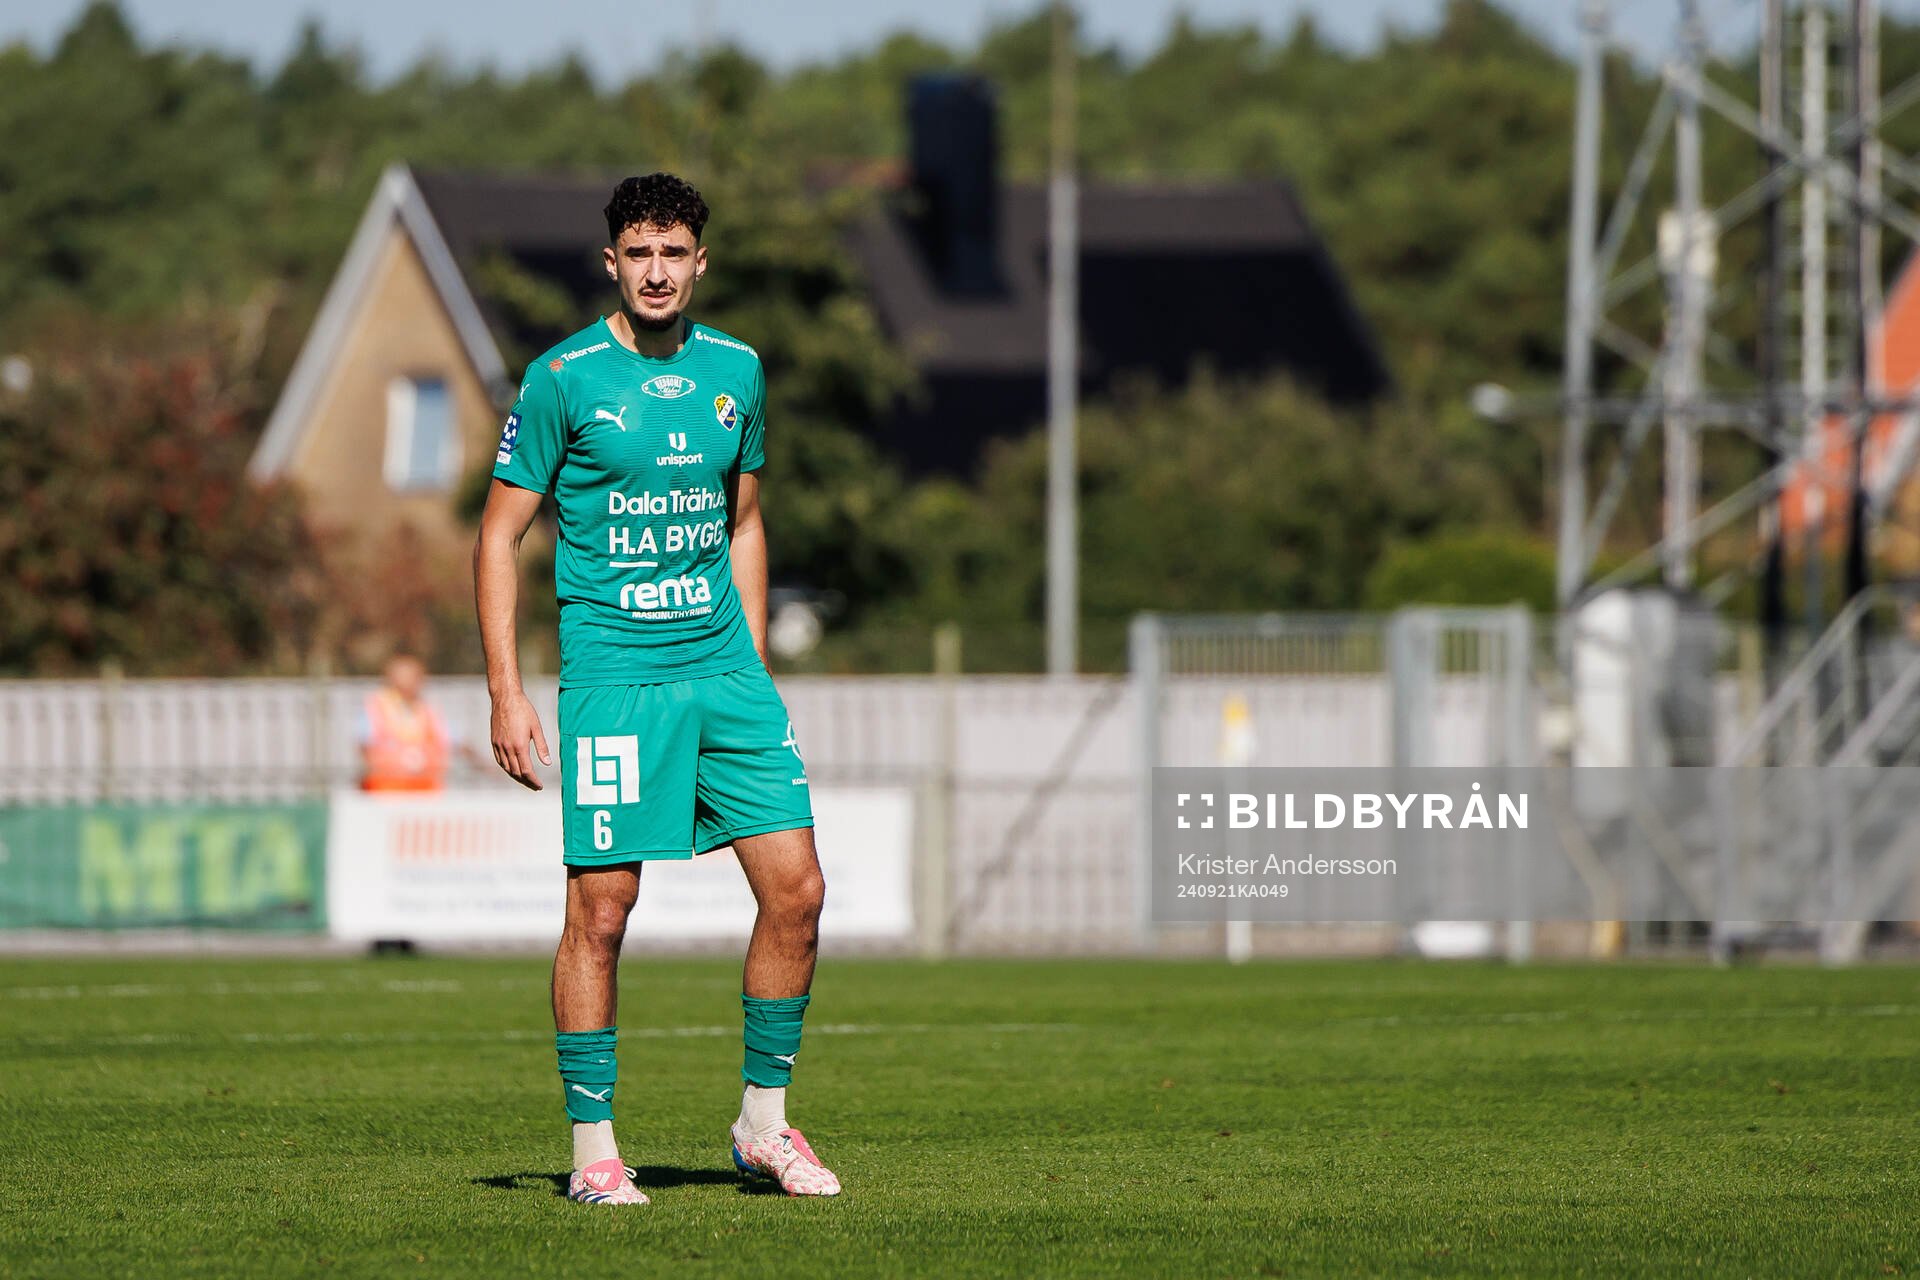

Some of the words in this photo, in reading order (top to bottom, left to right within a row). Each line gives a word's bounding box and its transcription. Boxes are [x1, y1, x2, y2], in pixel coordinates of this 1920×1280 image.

[560, 341, 611, 362] Takorama
[656, 452, 703, 467] unisport
[608, 526, 658, 555] H.A
[665, 518, 724, 552] BYGG
[619, 574, 712, 610] renta
[631, 605, 712, 620] MASKINUTHYRNING
[593, 809, 613, 851] 6
